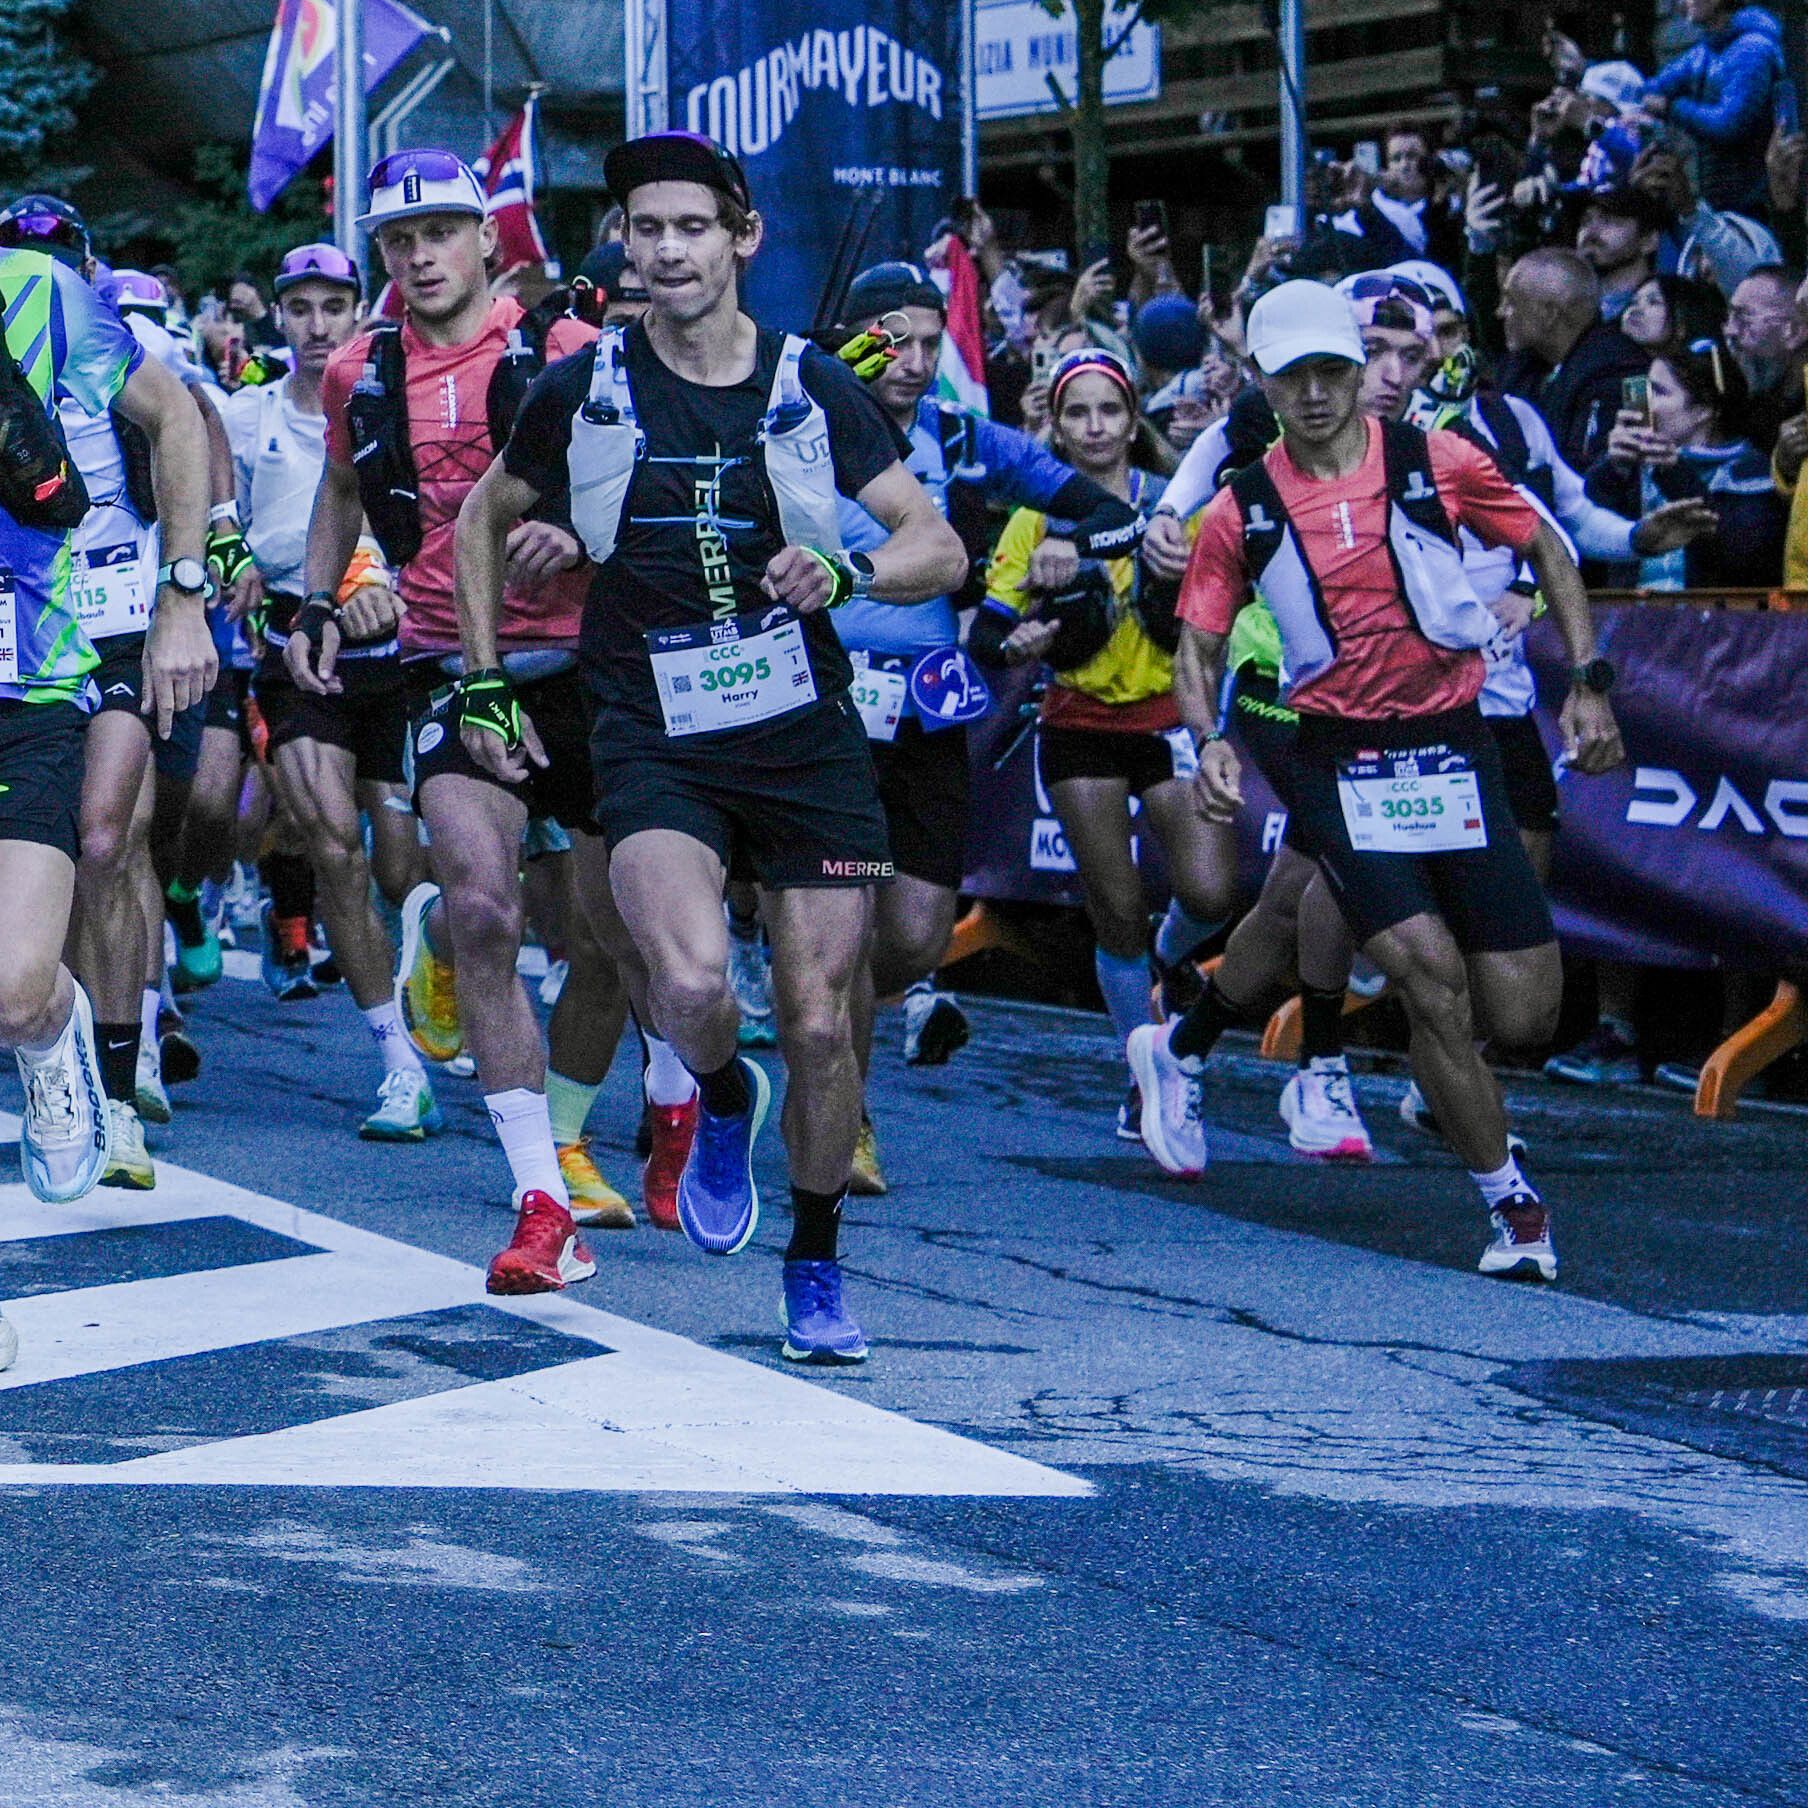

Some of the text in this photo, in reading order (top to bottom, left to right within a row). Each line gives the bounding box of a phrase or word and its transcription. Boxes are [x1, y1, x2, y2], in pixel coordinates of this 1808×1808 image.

[687, 24, 943, 157] COURMAYEUR
[833, 167, 943, 187] MONT BLANC
[695, 441, 738, 621] MERRELL
[73, 587, 107, 608] 115
[0, 628, 5, 639] 1
[709, 644, 741, 661] CCC
[791, 655, 798, 665] 1
[699, 656, 772, 692] 3095
[721, 689, 759, 704] Harry
[854, 687, 881, 706] 32
[488, 700, 511, 729] LEKI
[1391, 780, 1420, 793] CCC
[1379, 796, 1445, 818] 3035
[1626, 767, 1808, 838] DAC
[821, 859, 895, 877] MERRE
